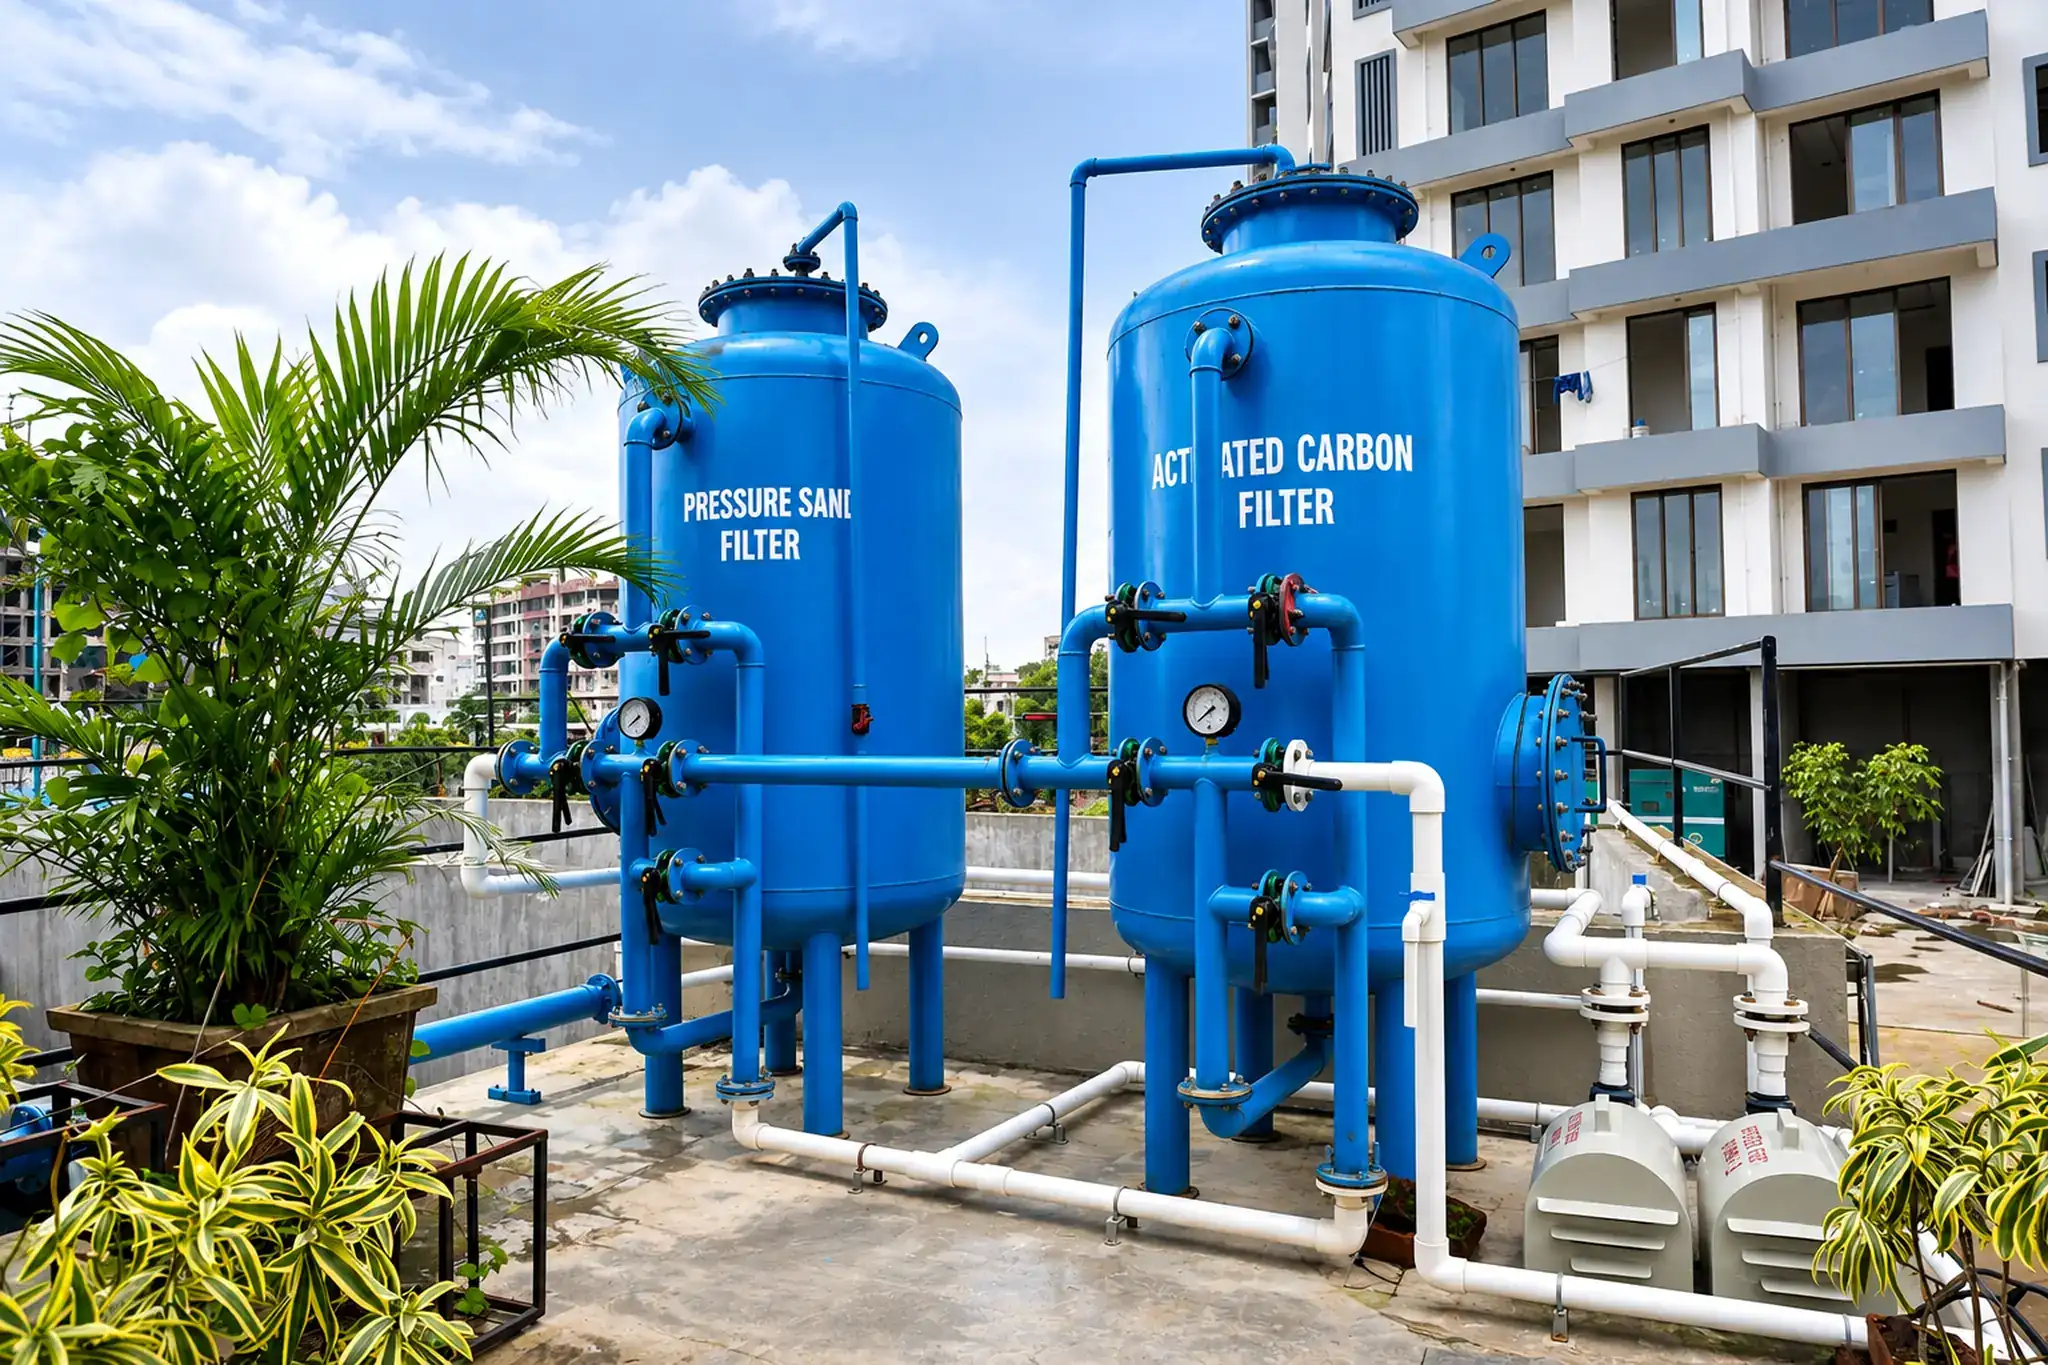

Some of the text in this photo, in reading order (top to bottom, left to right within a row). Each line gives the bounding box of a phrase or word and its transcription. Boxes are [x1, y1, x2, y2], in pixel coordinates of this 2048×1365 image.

[1152, 433, 1413, 490] ACTATED CARBON
[684, 487, 791, 522] PRESSURE
[1239, 488, 1335, 528] FILTER
[721, 528, 801, 562] FILTER
